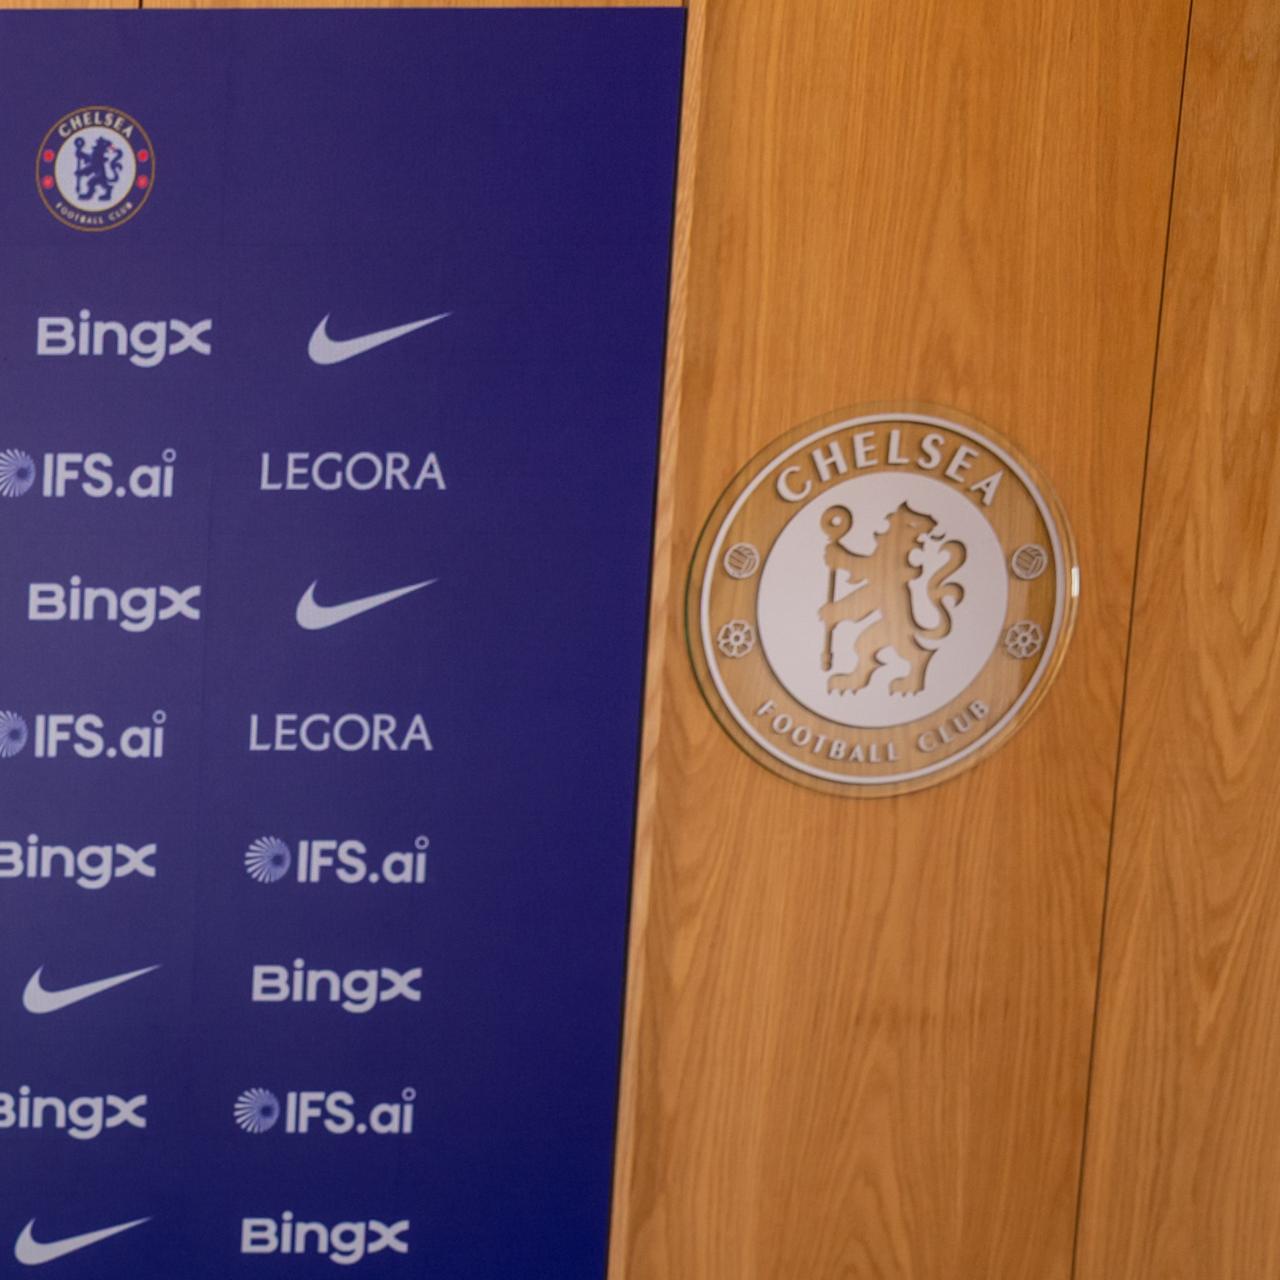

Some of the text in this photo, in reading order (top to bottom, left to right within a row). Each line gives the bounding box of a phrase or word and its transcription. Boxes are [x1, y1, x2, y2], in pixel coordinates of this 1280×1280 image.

[57, 111, 134, 139] CHELSEA
[42, 447, 177, 498] IFS.ai
[260, 451, 447, 491] LEGORA
[775, 429, 1005, 507] CHELSEA
[34, 709, 167, 759] IFS.ai
[248, 713, 434, 752] LEGORA
[755, 700, 989, 764] FOOTBALL CLUB
[297, 835, 430, 884] IFS.ai
[285, 1086, 417, 1135] IFS.ai
